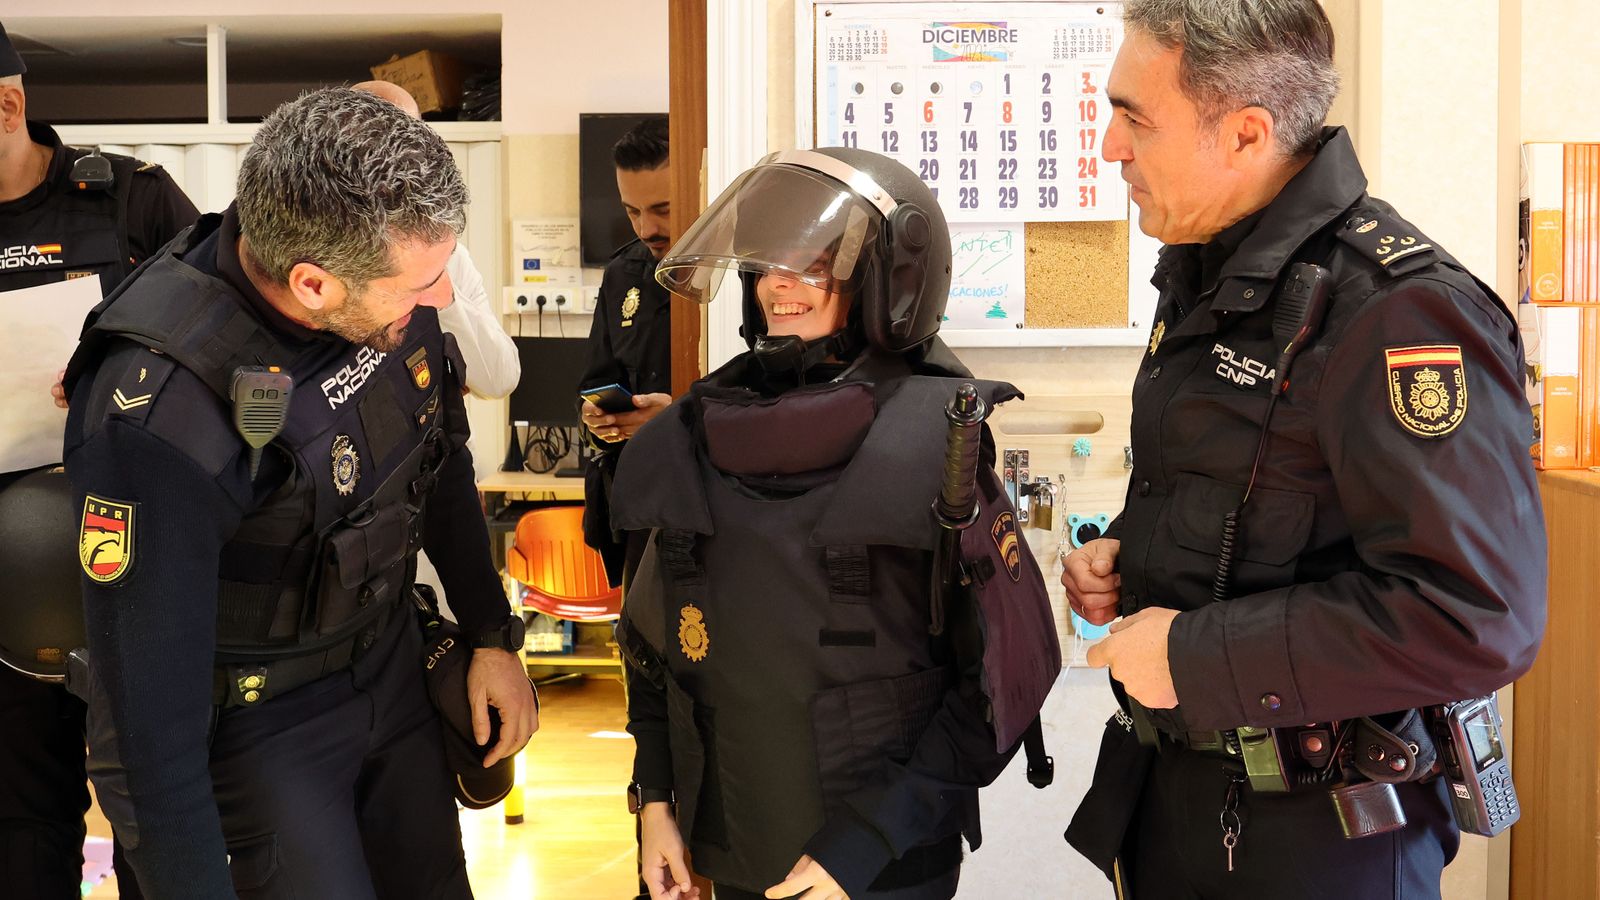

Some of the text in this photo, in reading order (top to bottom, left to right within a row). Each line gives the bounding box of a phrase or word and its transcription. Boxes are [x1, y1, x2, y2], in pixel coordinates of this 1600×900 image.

[922, 29, 1018, 43] DICIEMBRE
[1004, 74, 1010, 94] 1
[1042, 73, 1051, 94] 2
[1081, 72, 1092, 94] 3
[844, 100, 1097, 124] 4 5 6 7 8 9 10
[842, 129, 1096, 152] 11 12 13 14 15 16 17
[920, 158, 1098, 180] 20 21 22 23 24
[959, 187, 979, 208] 28
[998, 187, 1018, 208] 29
[1038, 186, 1058, 208] 30
[1079, 186, 1096, 208] 31
[0, 254, 63, 270] IONAL
[950, 283, 1008, 298] CACIONES!
[1211, 342, 1276, 380] POLICIA
[328, 351, 386, 410] NACIONA
[1216, 362, 1256, 386] CNP
[1392, 368, 1464, 432] CUERPO NACIONAL DE POLICIA
[426, 638, 454, 670] CNP
